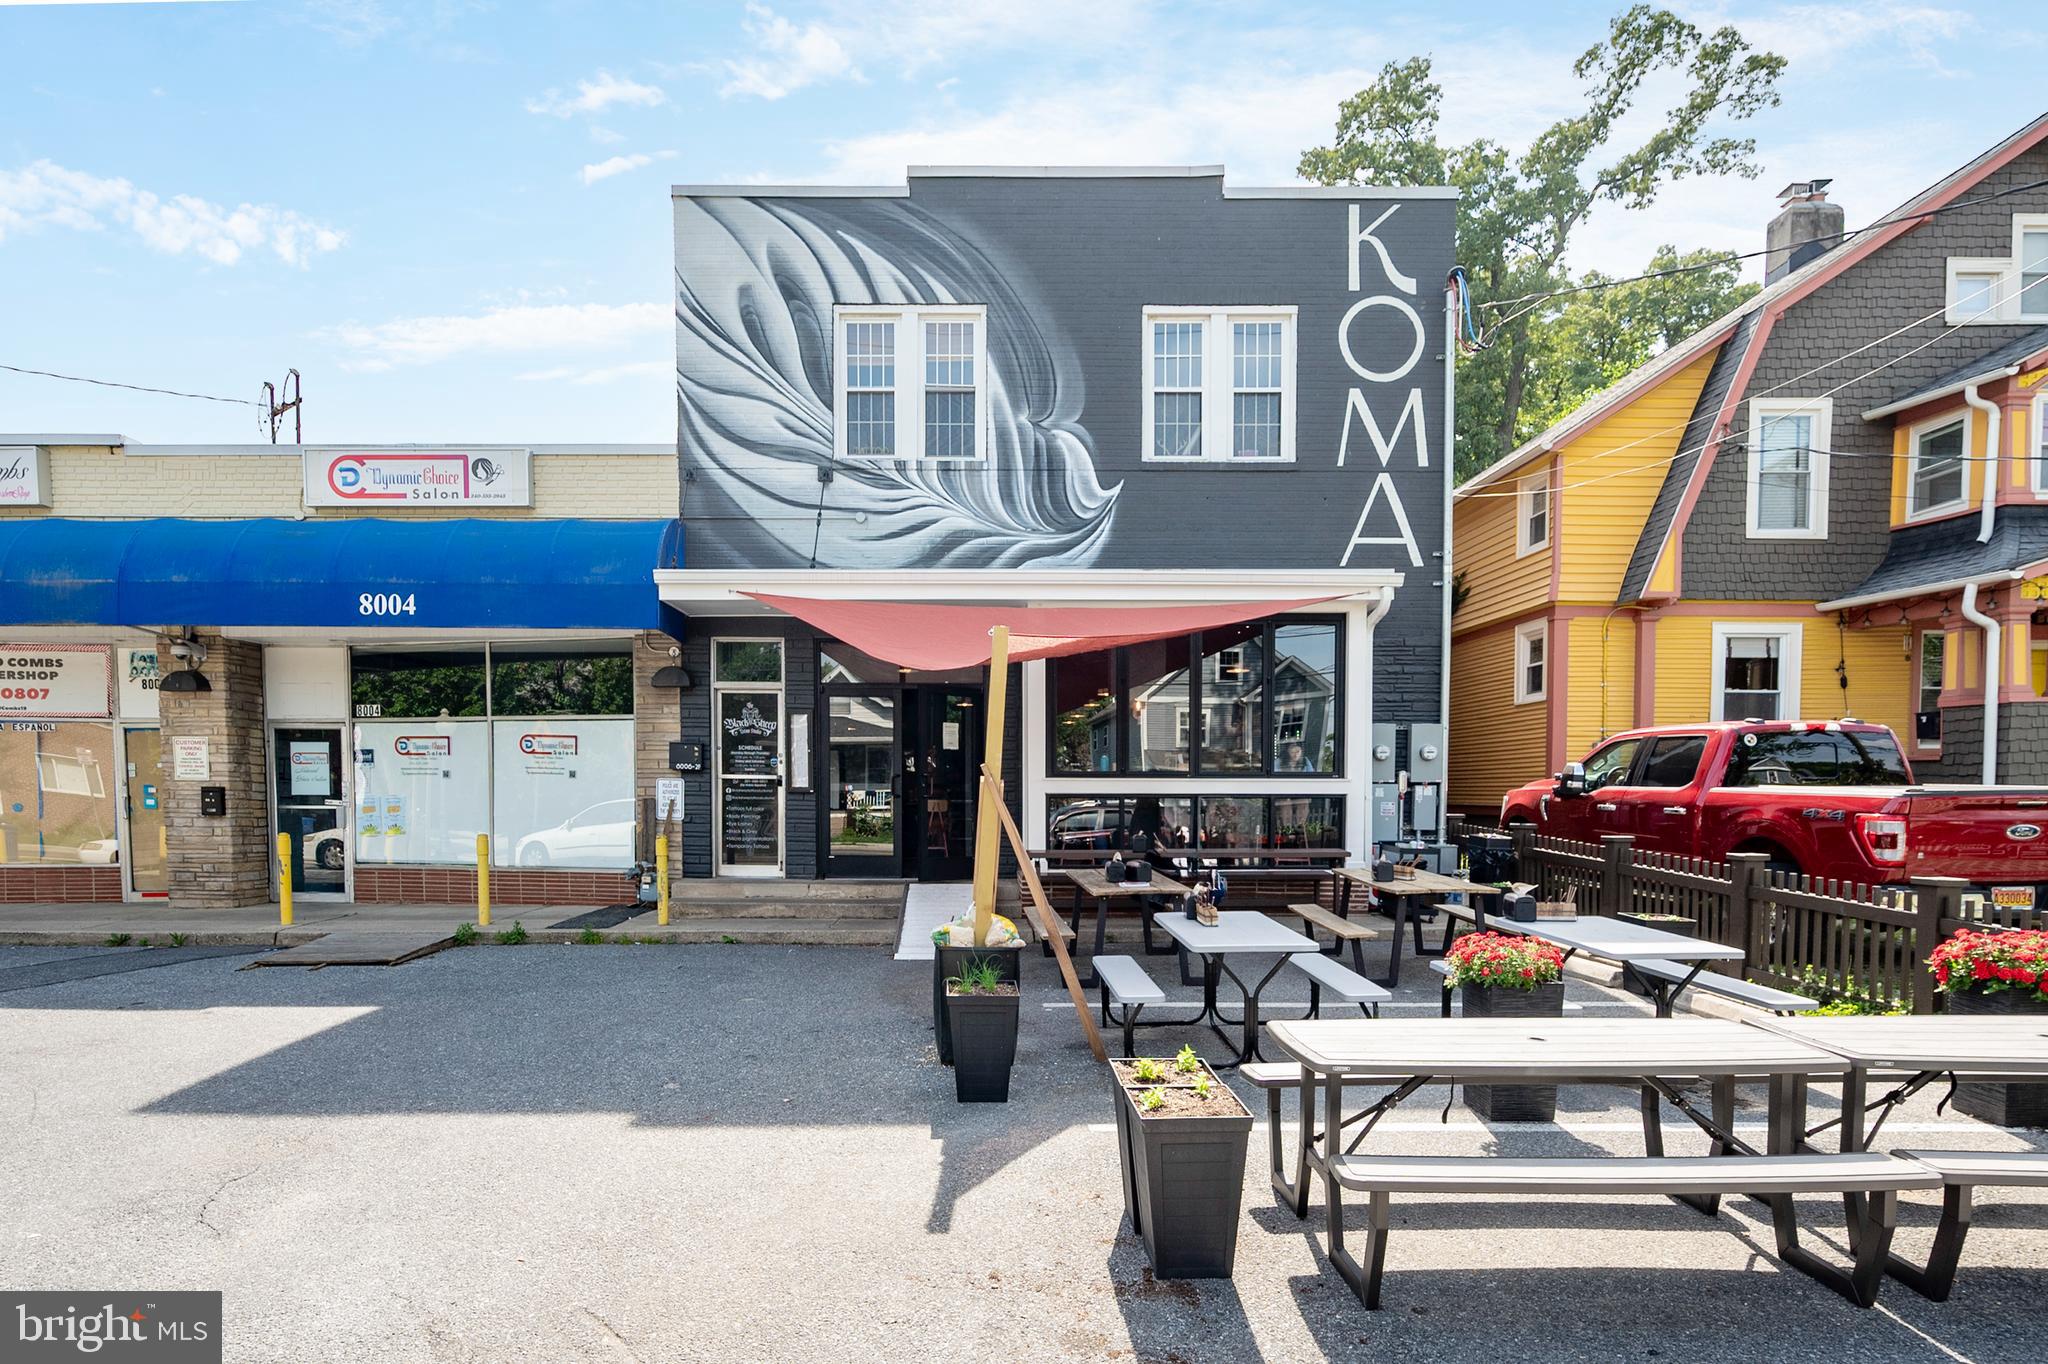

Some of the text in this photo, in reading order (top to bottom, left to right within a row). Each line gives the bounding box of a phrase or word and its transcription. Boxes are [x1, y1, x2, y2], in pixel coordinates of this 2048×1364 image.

[1337, 203, 1429, 568] KOMA
[366, 467, 422, 490] Dynamic
[423, 465, 459, 485] Choice
[413, 487, 459, 500] Salon
[359, 593, 417, 616] 8004
[7, 658, 64, 668] COMBS
[1, 687, 50, 700] 0807
[357, 704, 380, 716] 8004
[12, 723, 55, 731] ESPANOL
